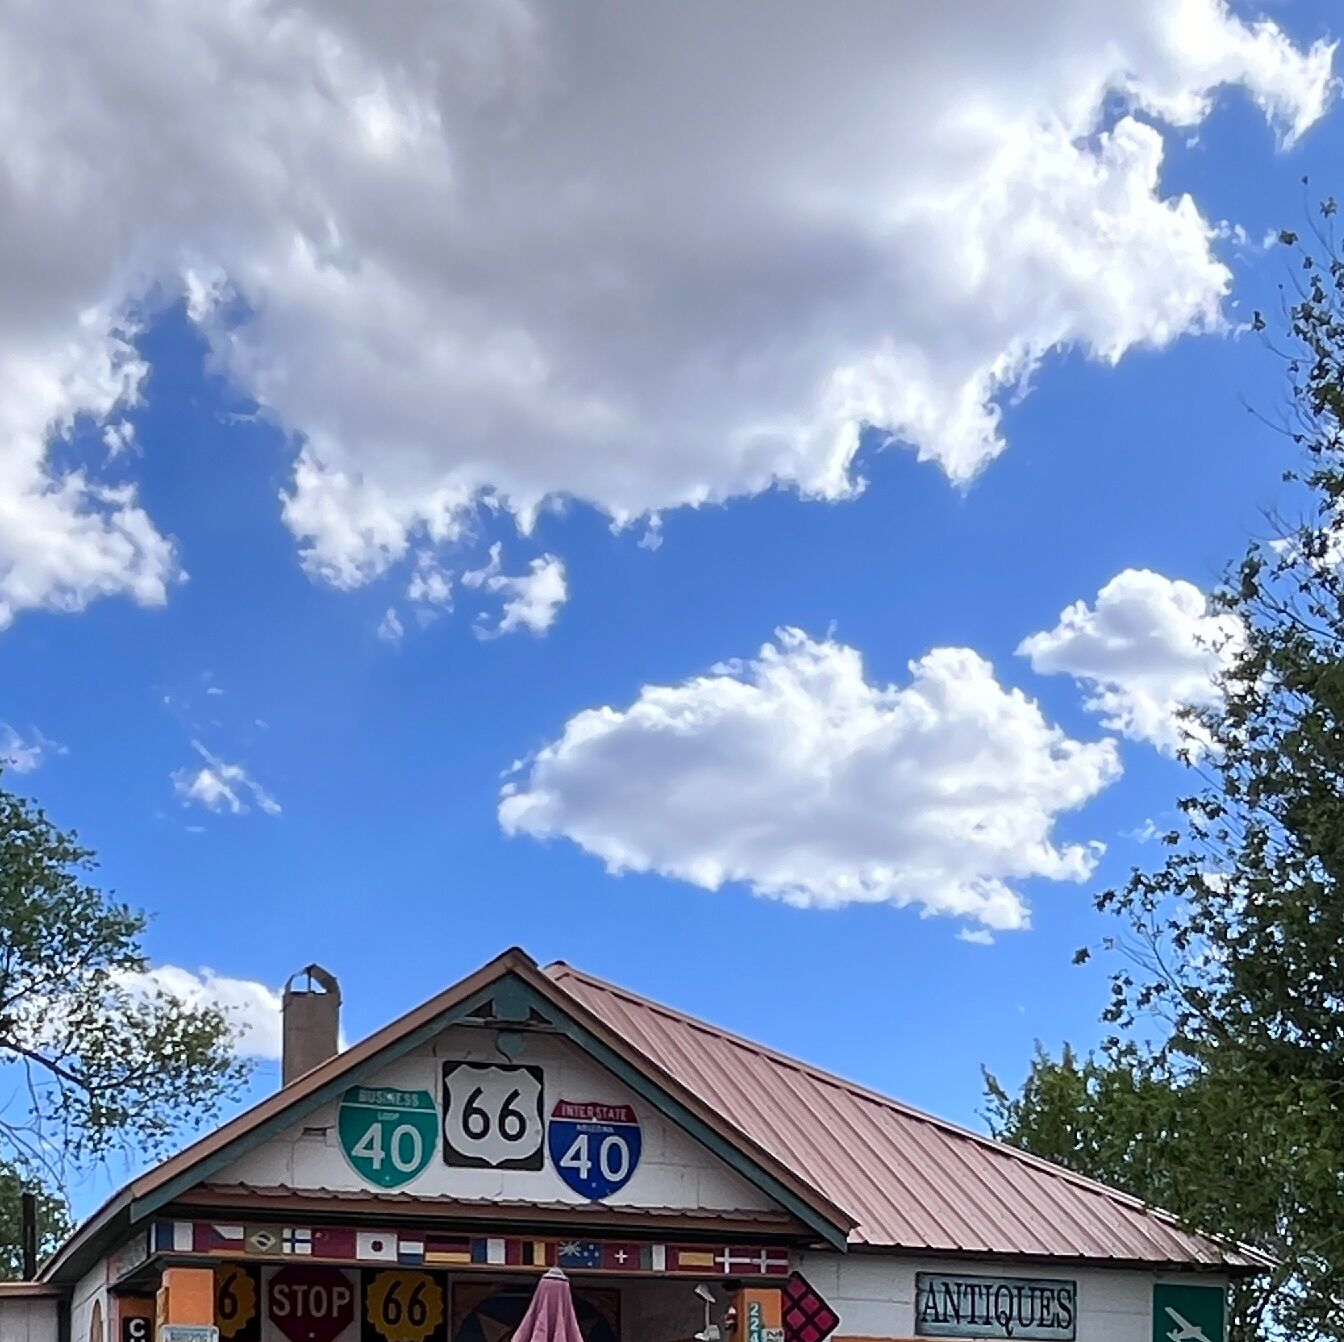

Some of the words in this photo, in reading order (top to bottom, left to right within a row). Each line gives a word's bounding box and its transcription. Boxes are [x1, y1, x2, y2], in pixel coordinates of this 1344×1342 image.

[358, 1089, 420, 1107] BUSINESS
[462, 1086, 527, 1142] 66
[561, 1104, 628, 1122] INTERSTATE
[351, 1122, 424, 1174] 40
[559, 1133, 631, 1183] 40
[272, 1284, 352, 1318] STOP
[381, 1280, 429, 1327] 66
[921, 1279, 1075, 1336] ANTIQUES
